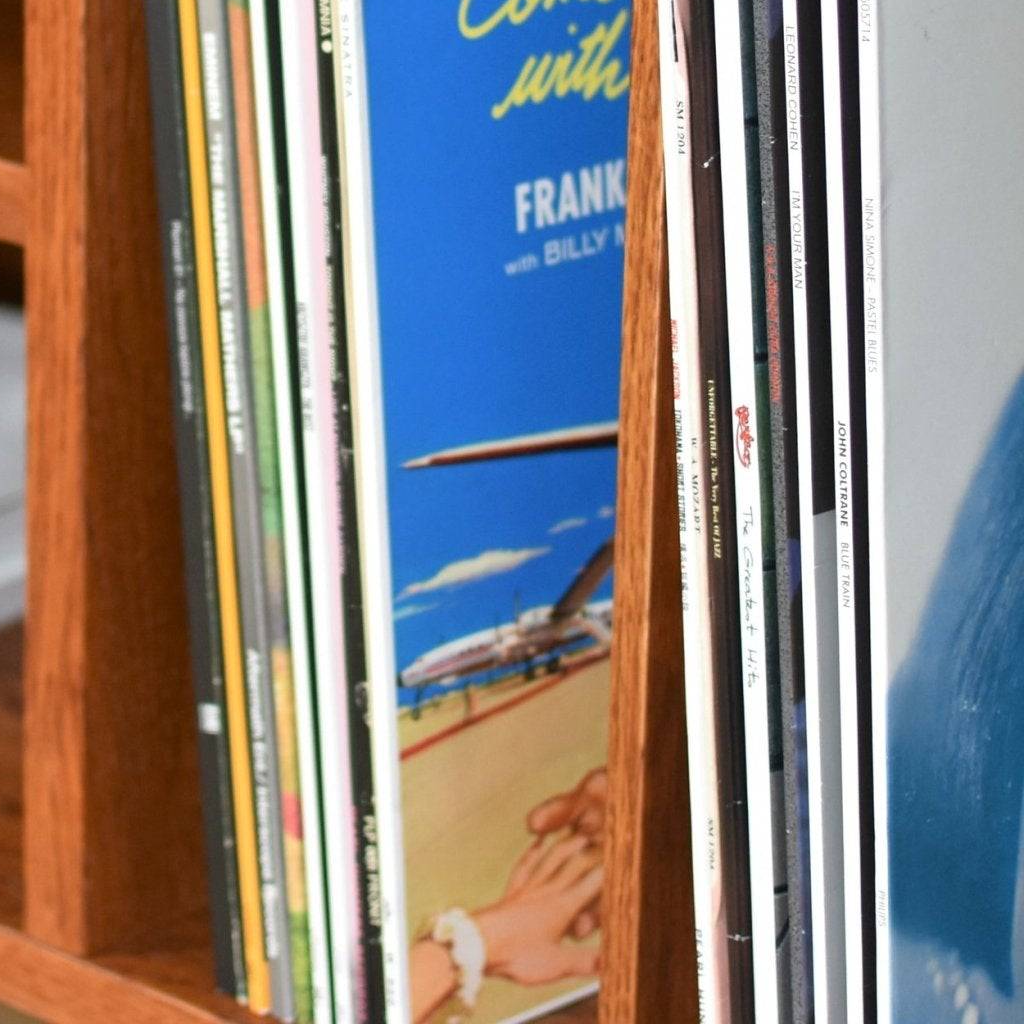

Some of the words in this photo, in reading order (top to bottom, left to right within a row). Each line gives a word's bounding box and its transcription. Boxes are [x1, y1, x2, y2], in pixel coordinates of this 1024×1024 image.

[340, 13, 353, 99] SINATRA
[491, 9, 631, 119] with
[785, 25, 797, 96] LEONARD
[675, 100, 685, 119] SM
[788, 98, 799, 151] COHEN
[676, 126, 687, 155] 1204
[514, 159, 627, 234] FRANK
[790, 189, 802, 212] I'M
[864, 197, 875, 232] NINA
[504, 254, 539, 277] with
[543, 227, 610, 267] BILLY
[791, 214, 803, 254] YOUR
[793, 258, 804, 290] MAN
[864, 234, 877, 282] SIMONE
[866, 296, 878, 336] PASTEL
[867, 338, 879, 373] BLUES
[707, 379, 717, 458] UNFORGETTABLE
[837, 420, 849, 458] JOHN
[710, 466, 719, 482] The
[710, 484, 719, 502] Very
[691, 472, 702, 535] MOZART
[712, 505, 720, 522] Best
[838, 461, 851, 527] COLTRANE
[742, 506, 754, 536] The
[712, 536, 723, 559] JAZZ
[840, 541, 851, 571] BLUE
[742, 546, 758, 637] Greatest
[841, 573, 853, 608] TRAIN
[746, 648, 760, 690] Hits
